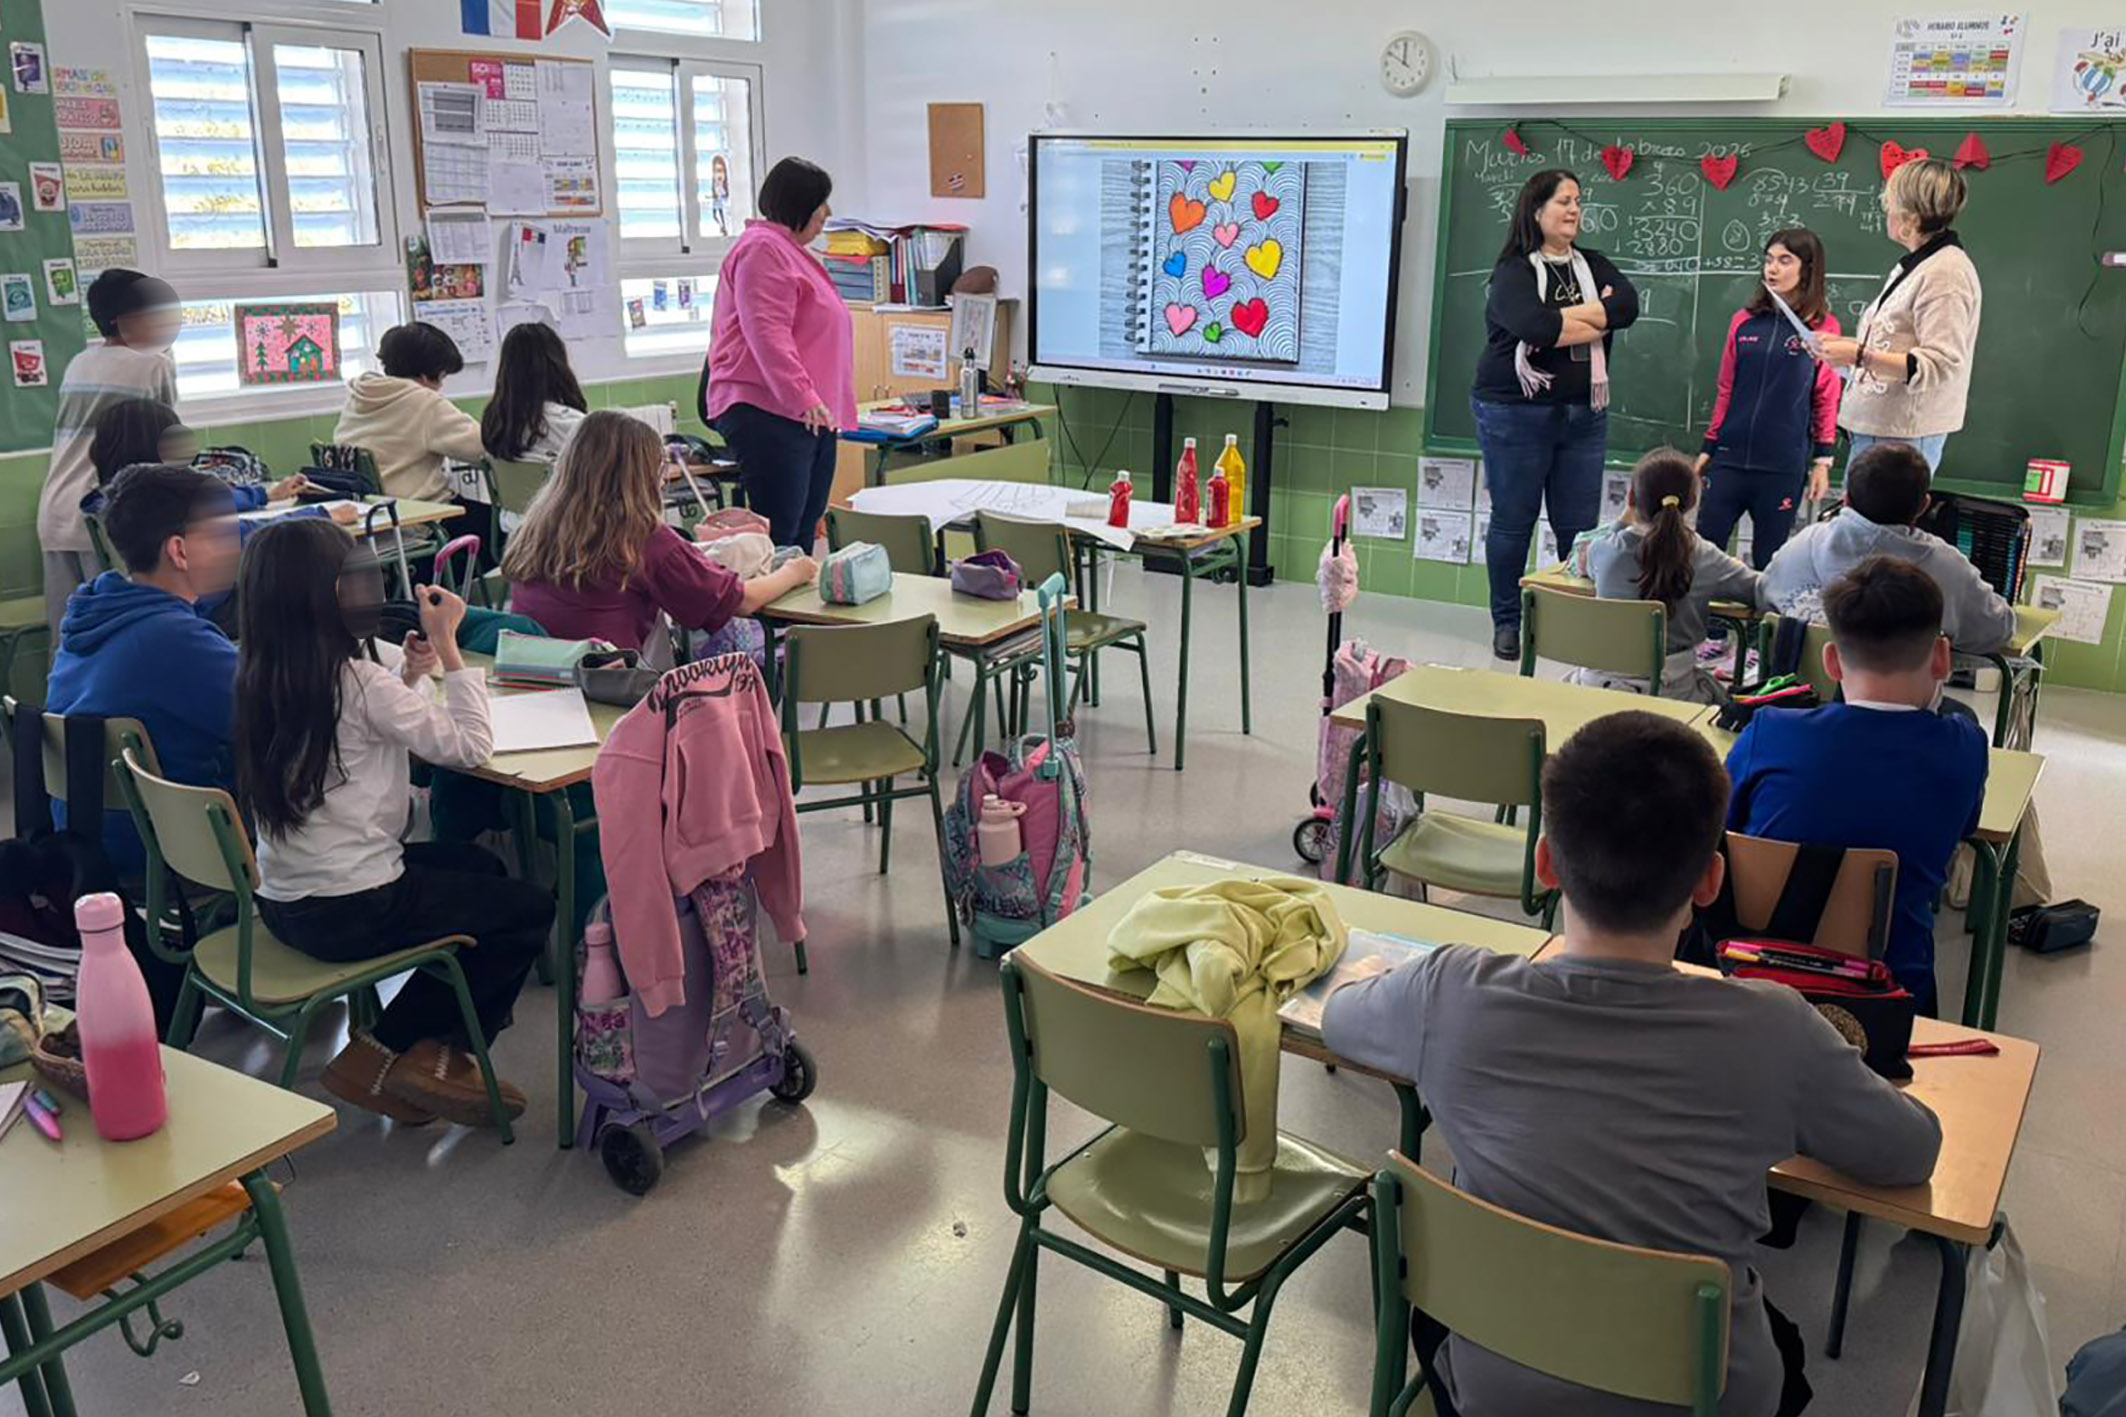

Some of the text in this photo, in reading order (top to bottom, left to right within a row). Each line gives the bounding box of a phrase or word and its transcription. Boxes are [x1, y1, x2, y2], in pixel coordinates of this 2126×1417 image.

[2090, 31, 2121, 49] J'ai
[1552, 138, 1576, 167] 17
[1641, 171, 1700, 197] 360
